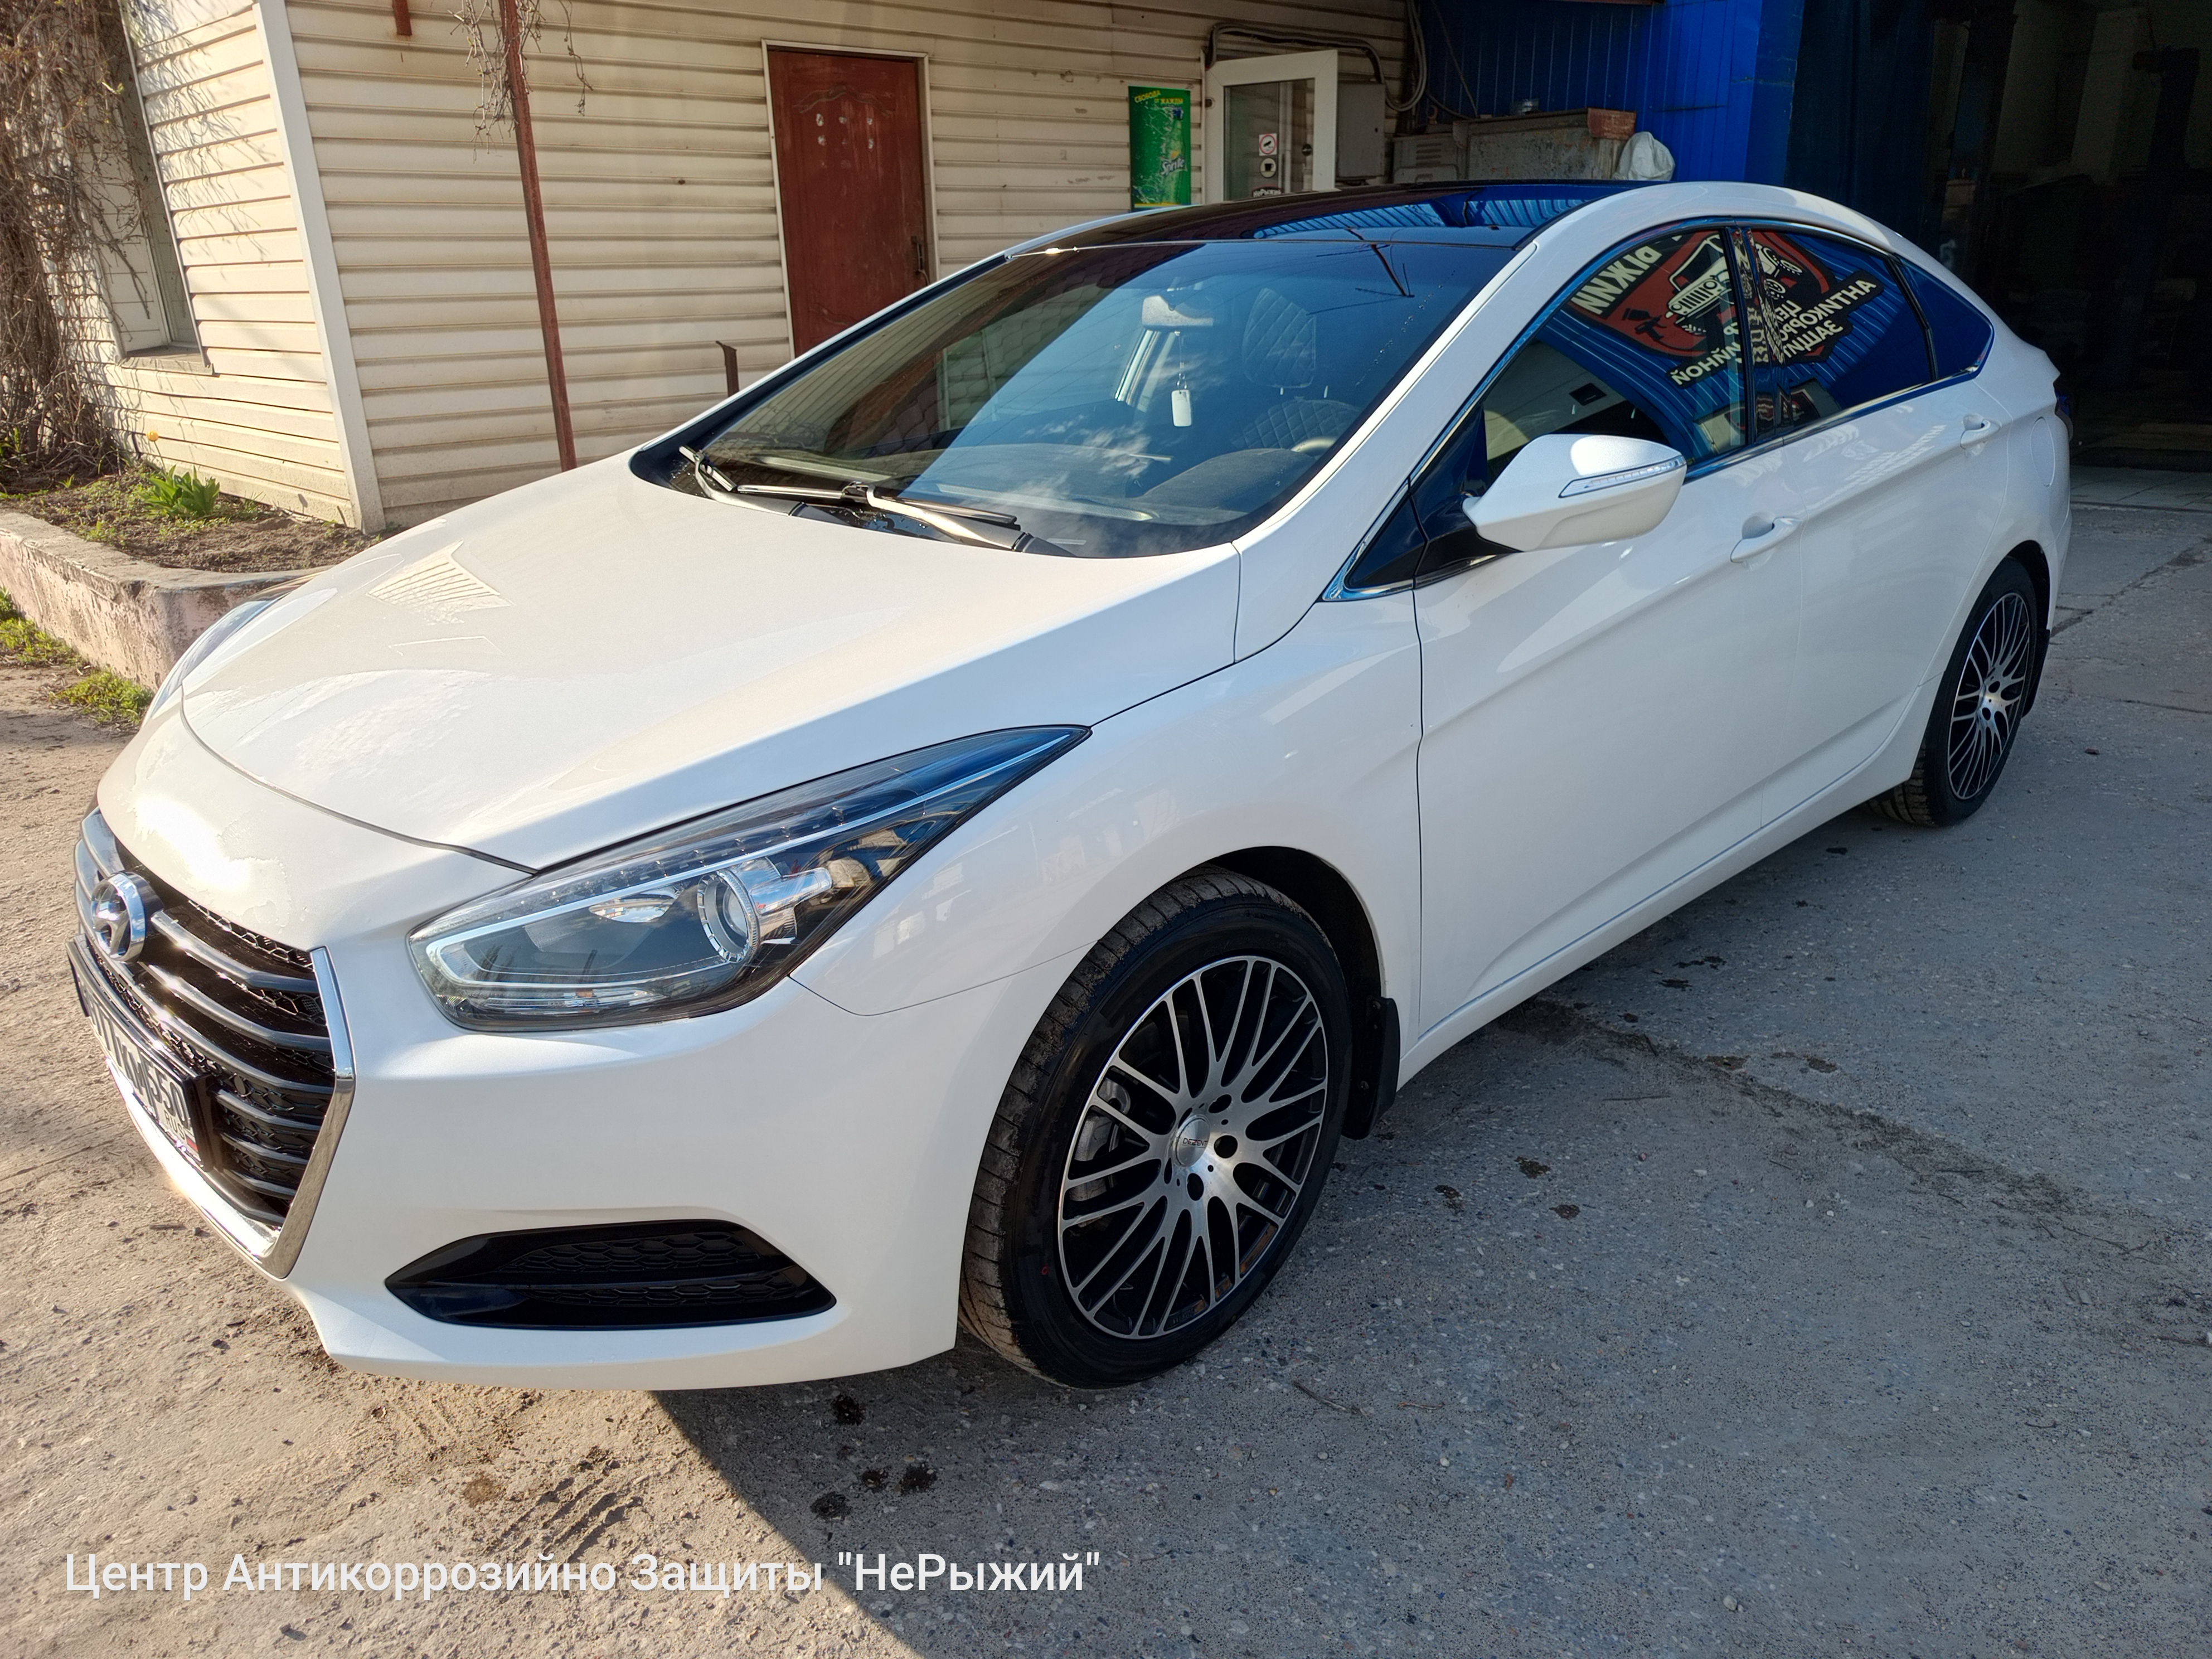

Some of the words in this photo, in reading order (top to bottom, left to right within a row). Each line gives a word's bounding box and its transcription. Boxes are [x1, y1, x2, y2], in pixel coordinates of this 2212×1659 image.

[1160, 157, 1185, 176] Sprite
[165, 1110, 185, 1138] RUS
[1182, 1138, 1209, 1147] DEZENT
